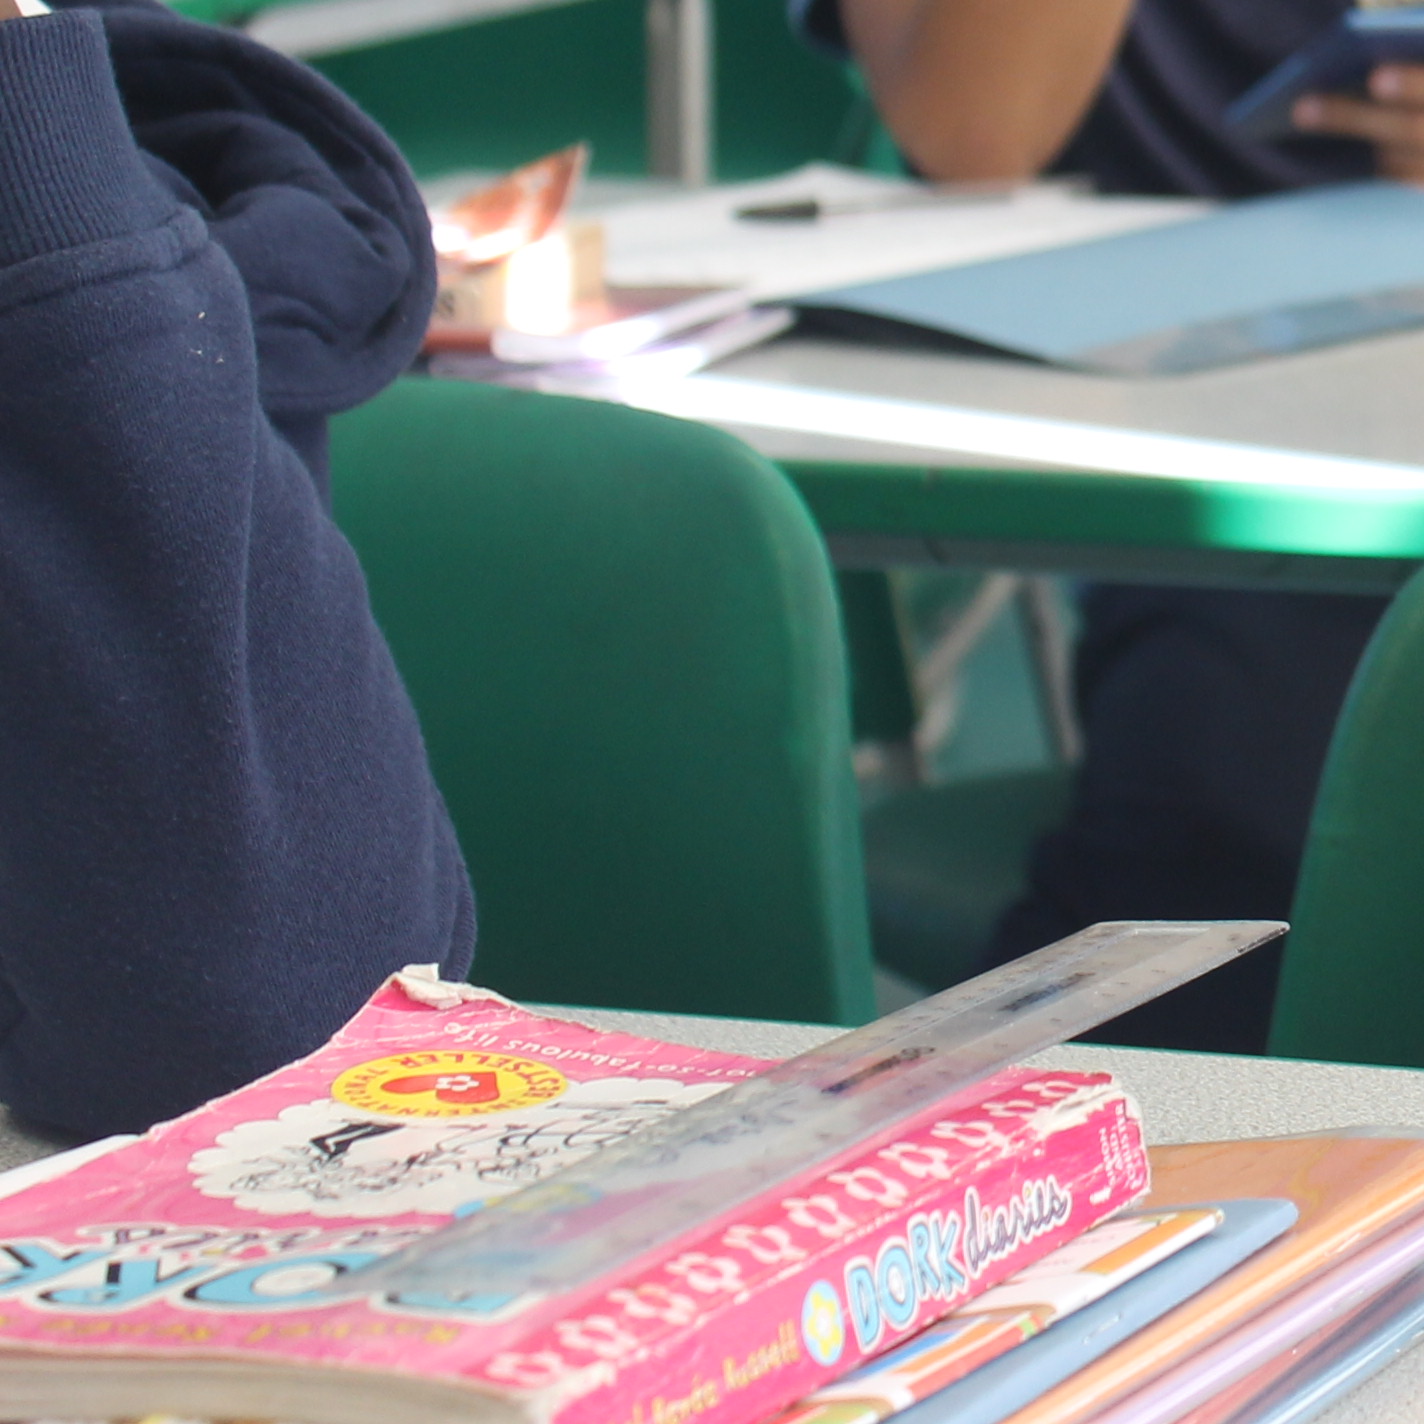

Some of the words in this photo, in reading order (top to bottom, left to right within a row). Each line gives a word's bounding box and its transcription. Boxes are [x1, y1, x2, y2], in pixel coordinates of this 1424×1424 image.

[443, 1022, 500, 1048] life
[397, 1053, 560, 1098] BESTSELLER
[845, 1214, 967, 1350] DORK
[965, 1178, 1071, 1275] diaries
